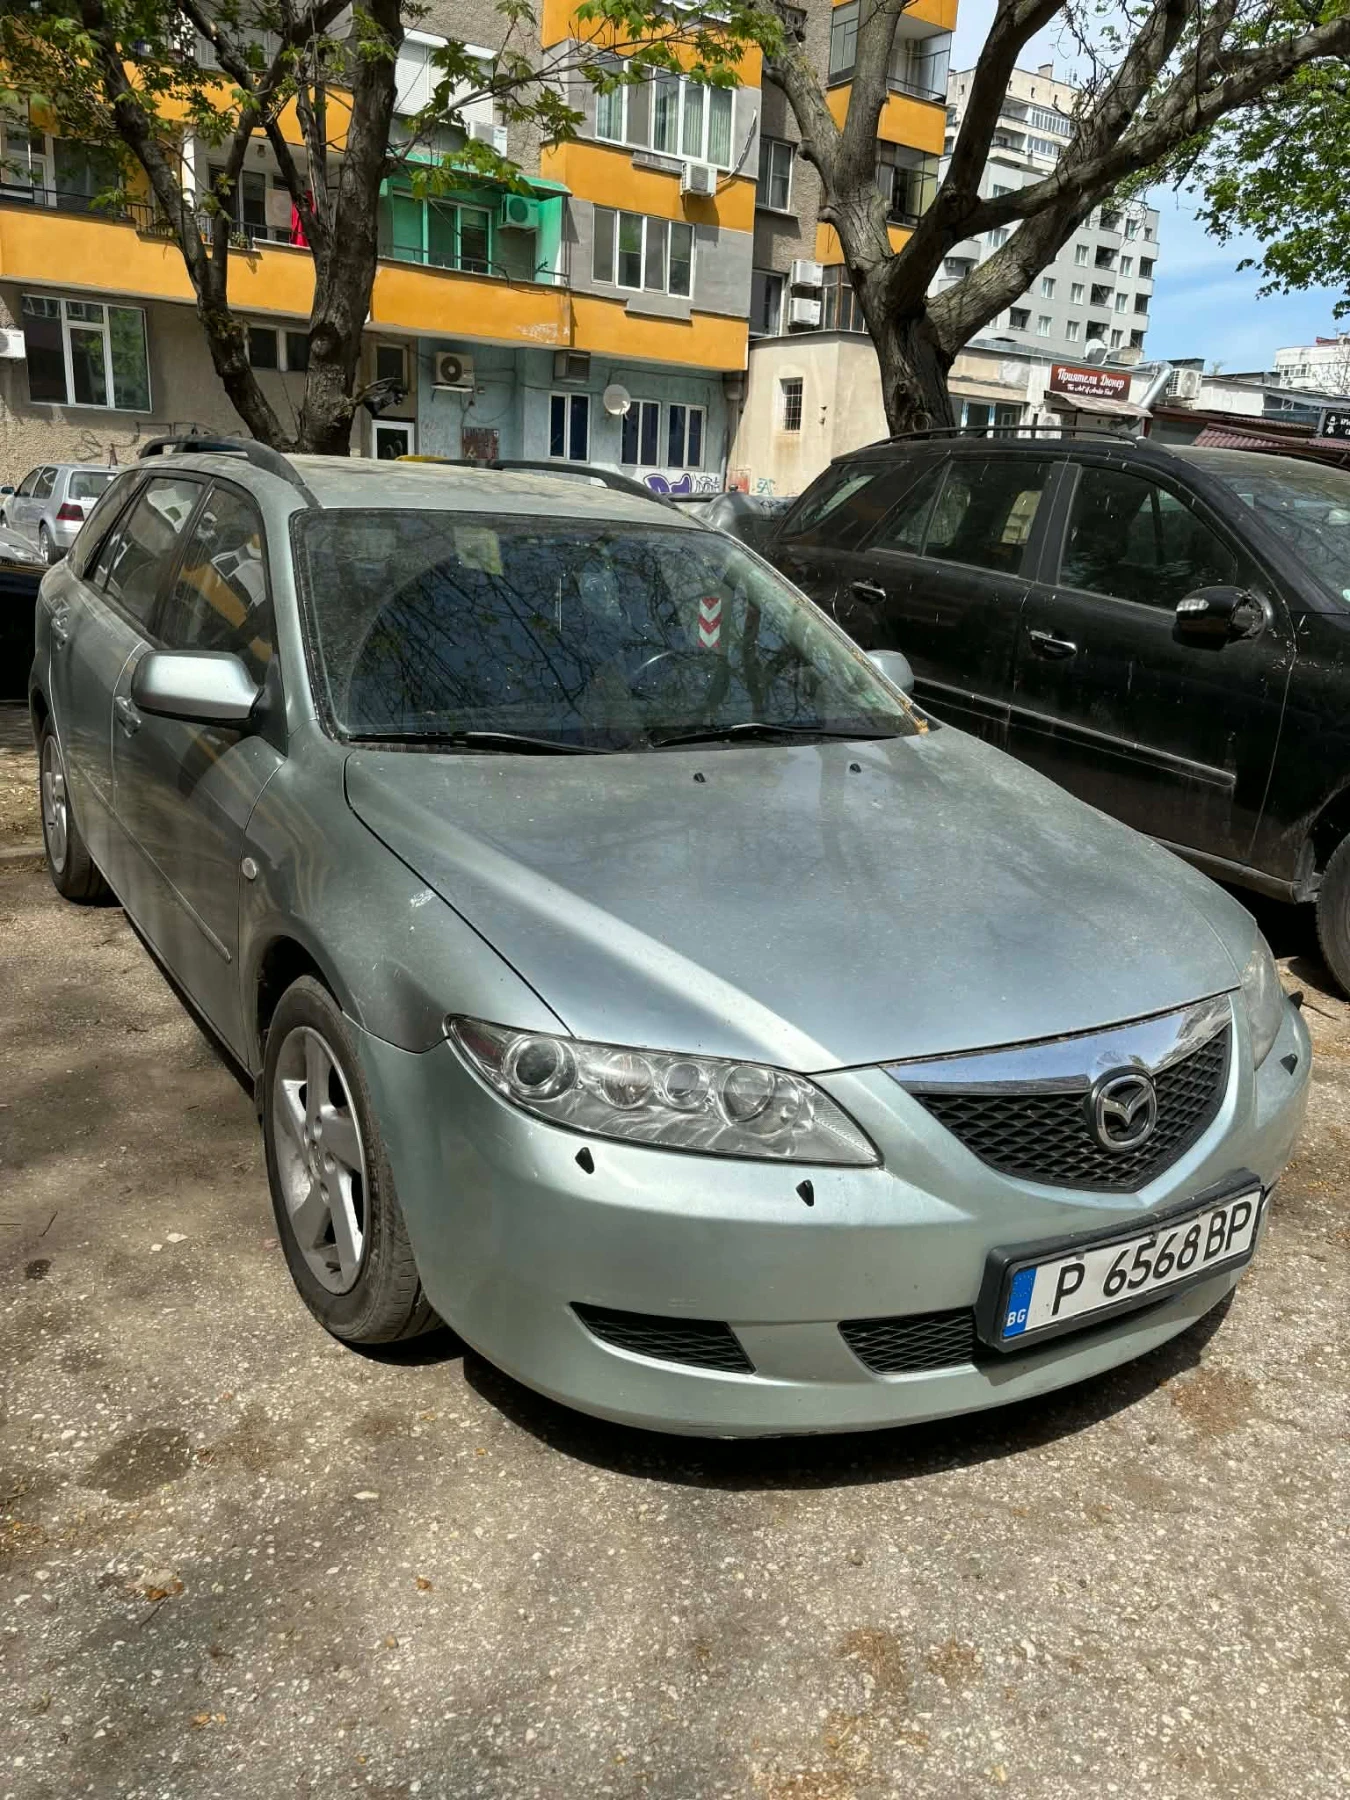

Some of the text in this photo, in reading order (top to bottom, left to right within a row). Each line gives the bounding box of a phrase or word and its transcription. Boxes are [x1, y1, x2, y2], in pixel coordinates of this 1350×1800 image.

[1058, 368, 1125, 391] Приятели Дюнер
[1052, 1262, 1085, 1316] P
[1006, 1309, 1026, 1327] BG
